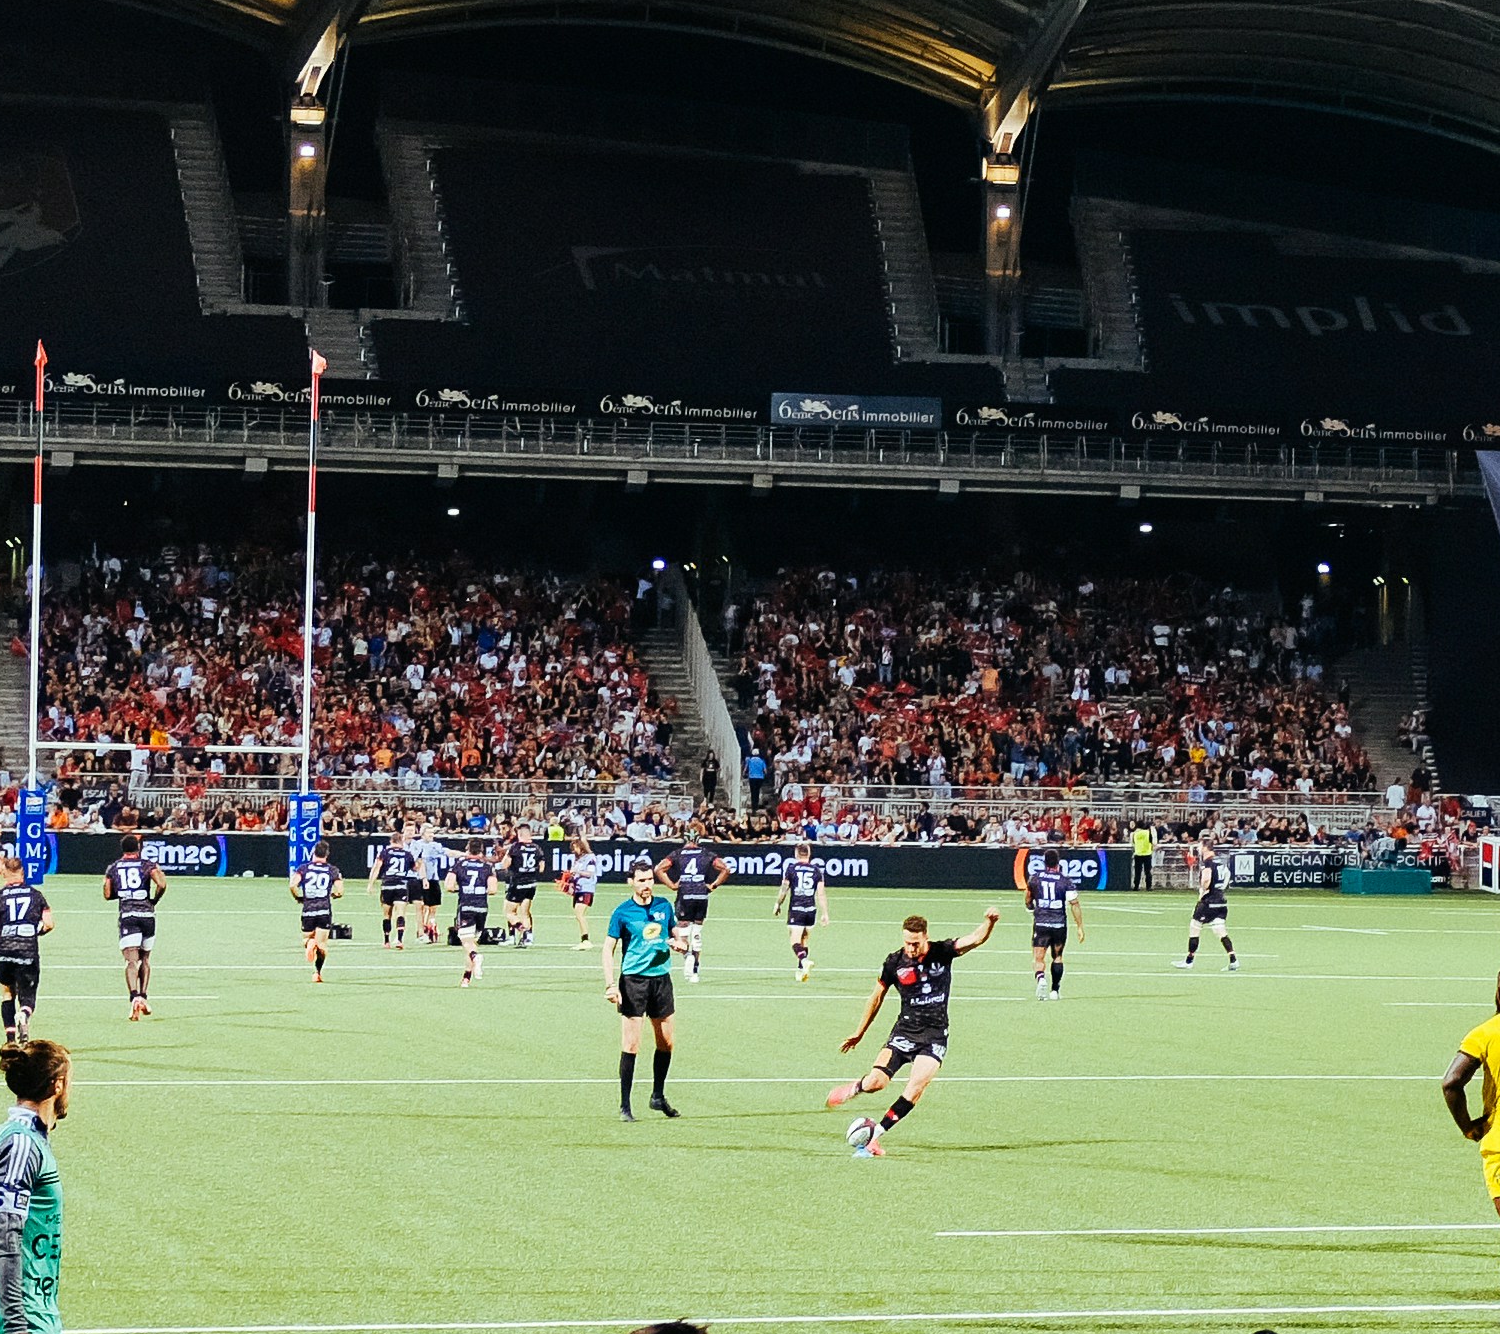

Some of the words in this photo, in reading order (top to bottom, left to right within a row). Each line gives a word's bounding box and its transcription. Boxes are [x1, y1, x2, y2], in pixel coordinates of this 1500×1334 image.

[129, 384, 206, 398] immobilier
[319, 394, 392, 407] mmobilier
[501, 400, 576, 414] immobilier
[684, 406, 758, 419] immobilier
[862, 410, 934, 424] immobilier
[1038, 418, 1108, 431] immobilier
[1212, 422, 1281, 436] immobilier
[1379, 429, 1447, 442] immobilier
[141, 843, 217, 865] em2c
[552, 848, 652, 876] inpiré
[385, 857, 407, 876] 21
[684, 858, 699, 875] 4
[117, 867, 142, 890] 18
[304, 872, 330, 891] 20
[796, 872, 814, 890] 15
[1041, 881, 1056, 900] 11
[5, 897, 31, 922] 17
